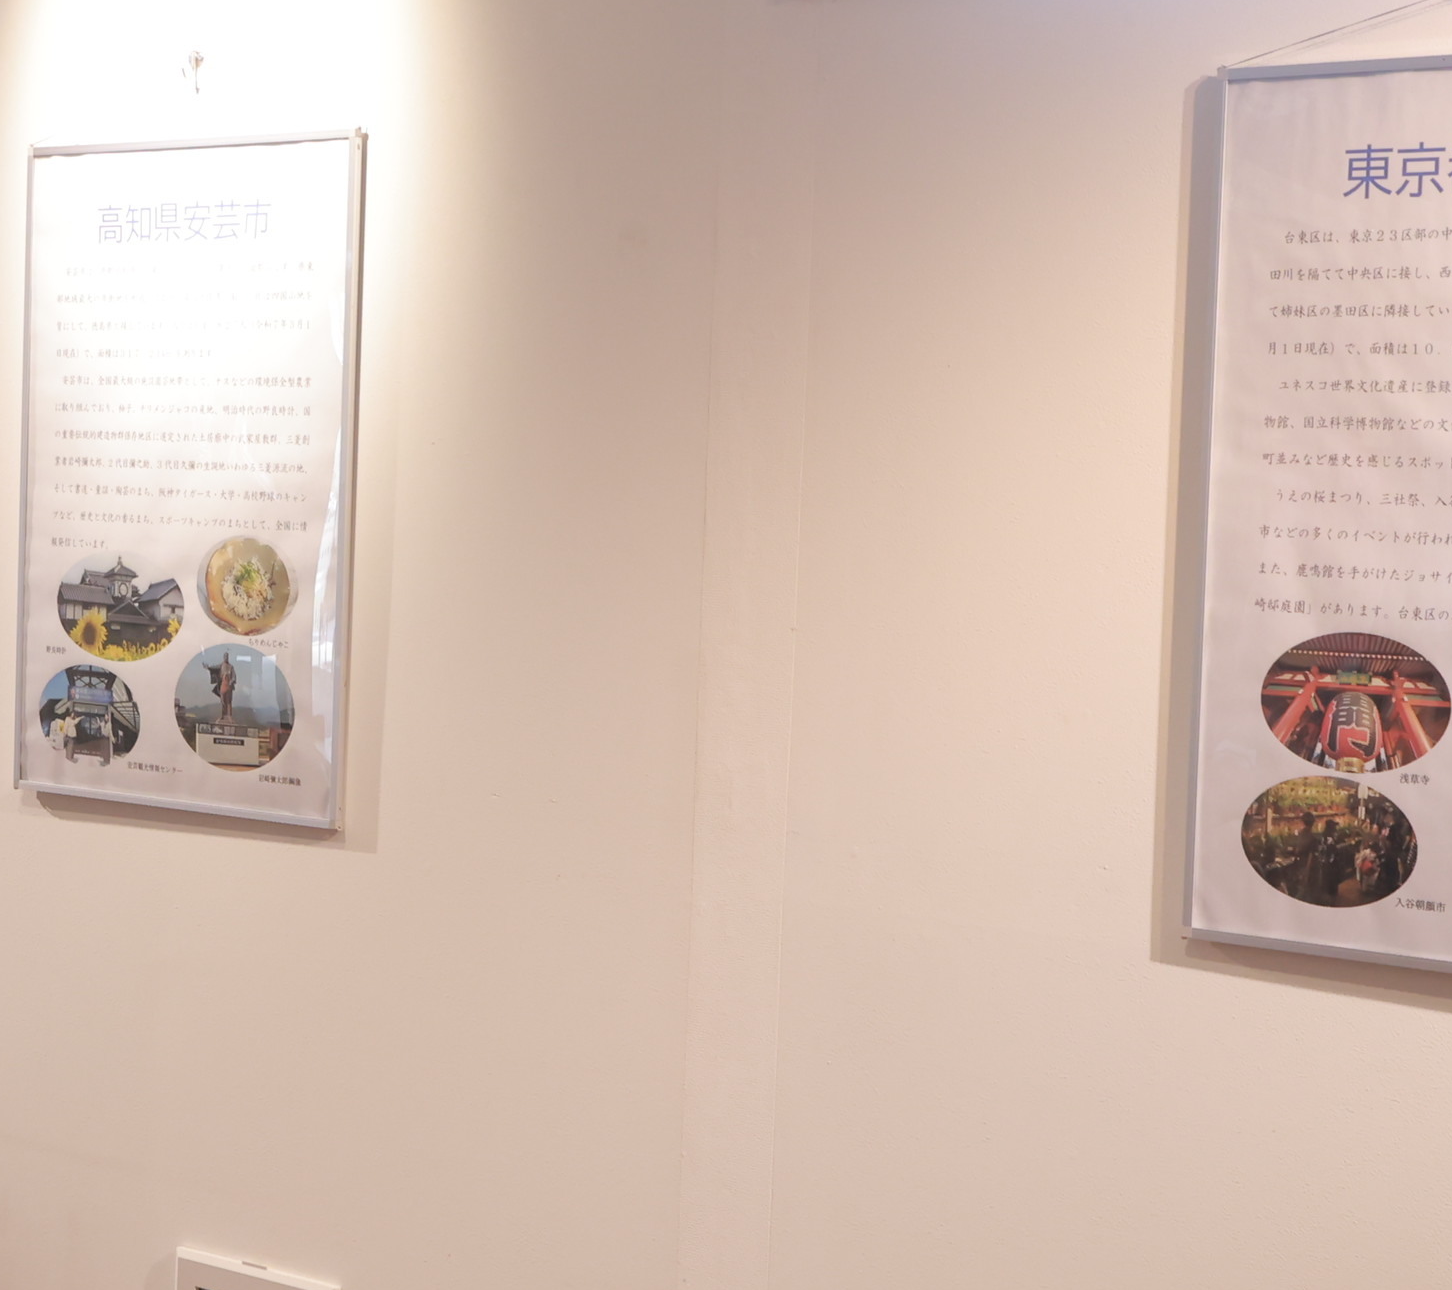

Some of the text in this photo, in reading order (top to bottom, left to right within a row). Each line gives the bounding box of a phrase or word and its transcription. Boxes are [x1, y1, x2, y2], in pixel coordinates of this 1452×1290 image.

[97, 198, 272, 244] 高知県安芸市
[1399, 773, 1430, 786] 浅草寺
